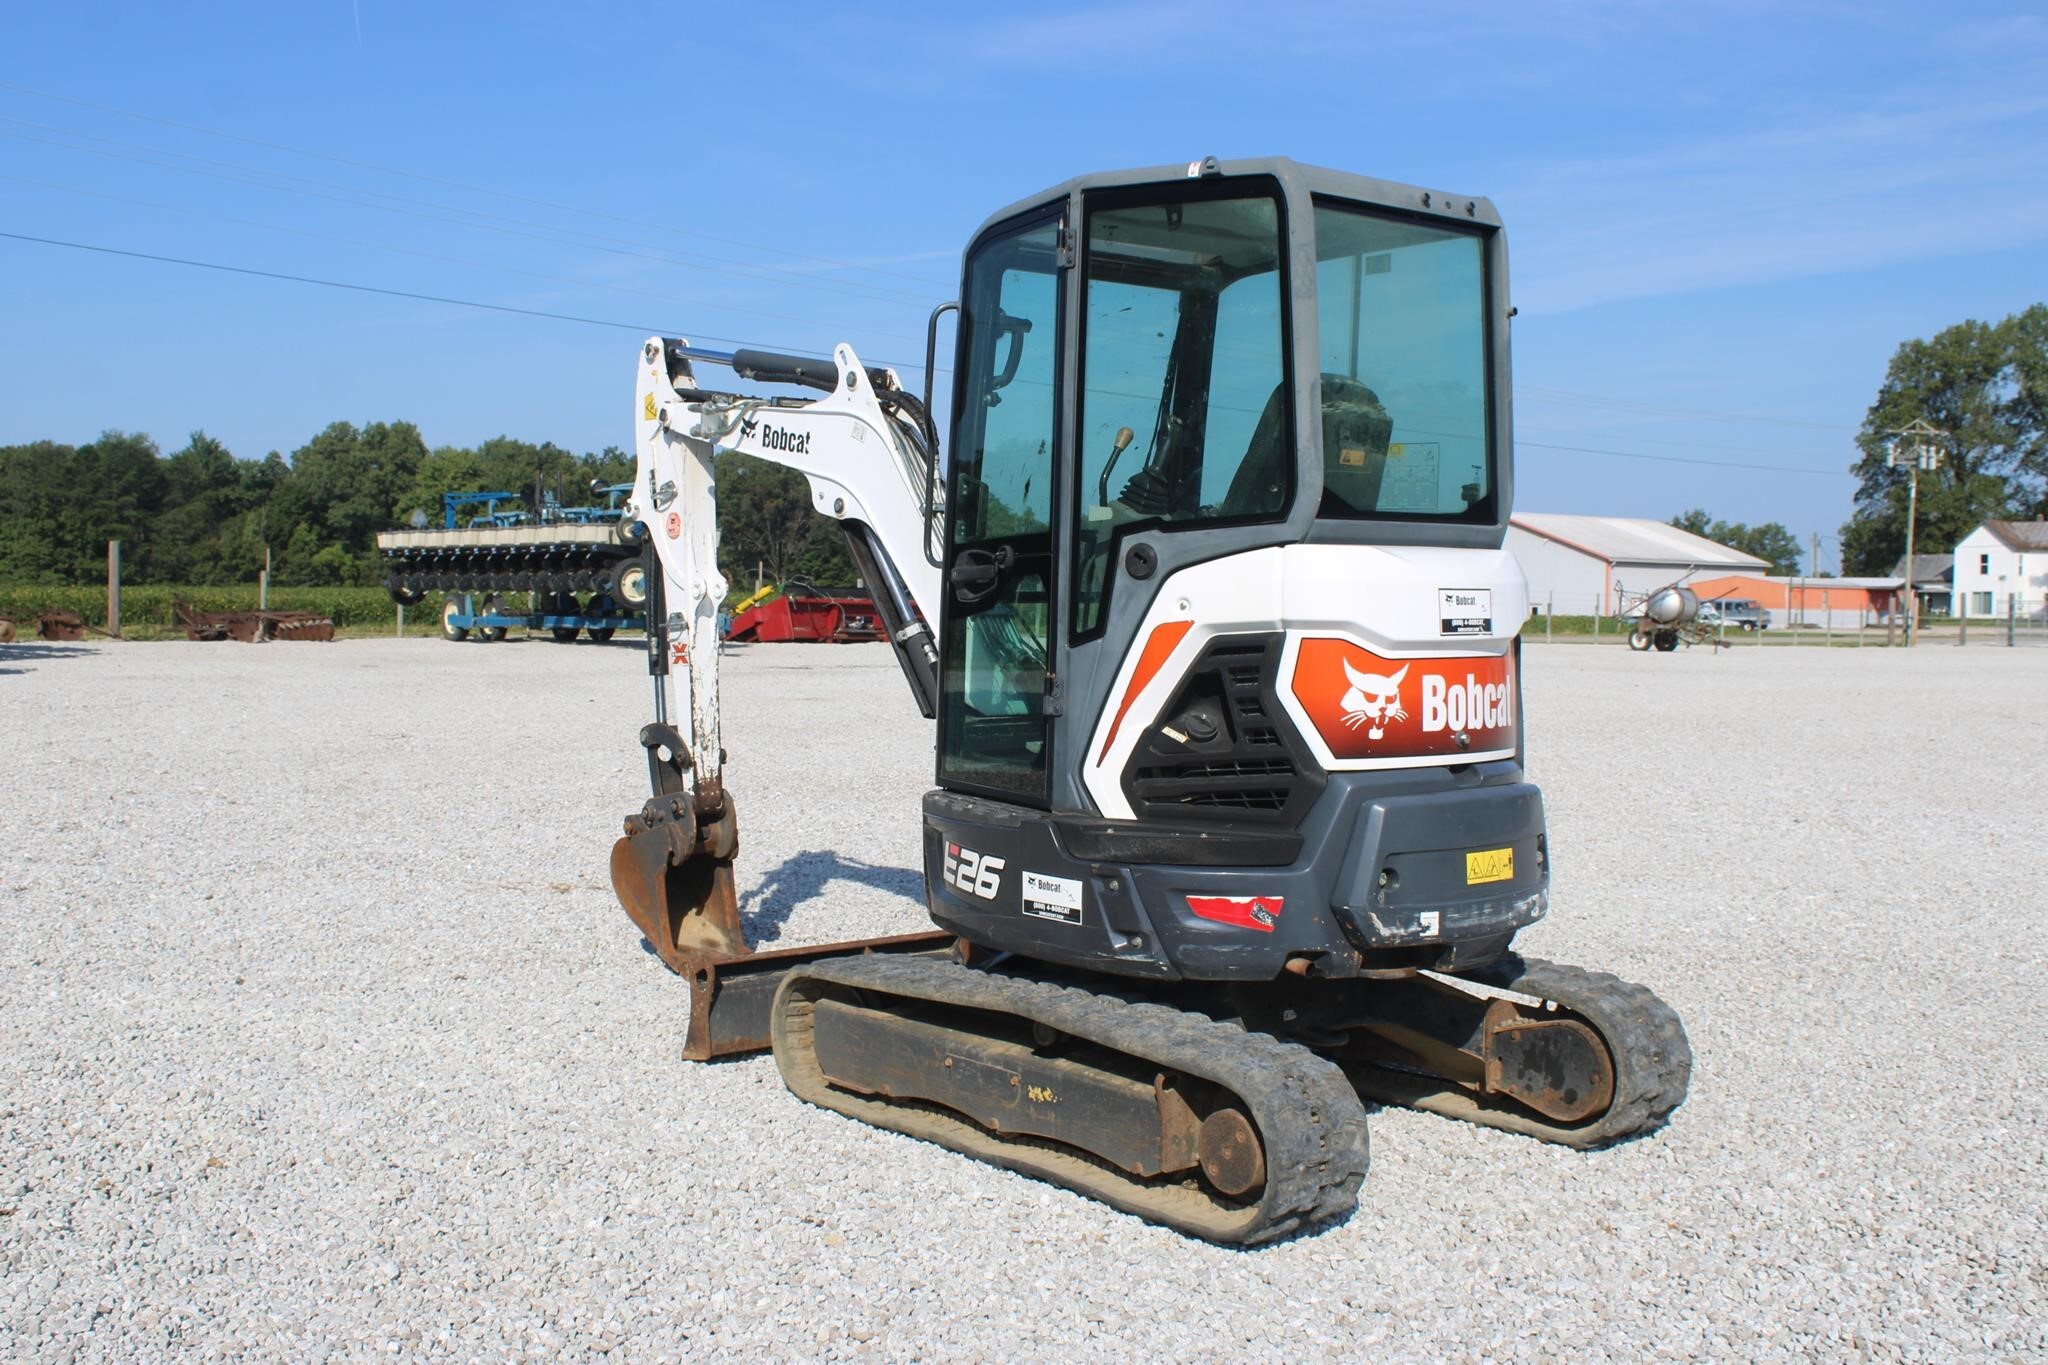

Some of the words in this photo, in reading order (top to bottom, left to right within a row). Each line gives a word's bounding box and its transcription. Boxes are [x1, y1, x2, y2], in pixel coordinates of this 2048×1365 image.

[762, 424, 811, 455] Bobcat
[1456, 595, 1476, 606] Bobcat
[1422, 673, 1512, 732] Bobcat
[943, 840, 1006, 900] E26
[1038, 879, 1061, 893] Bobcat
